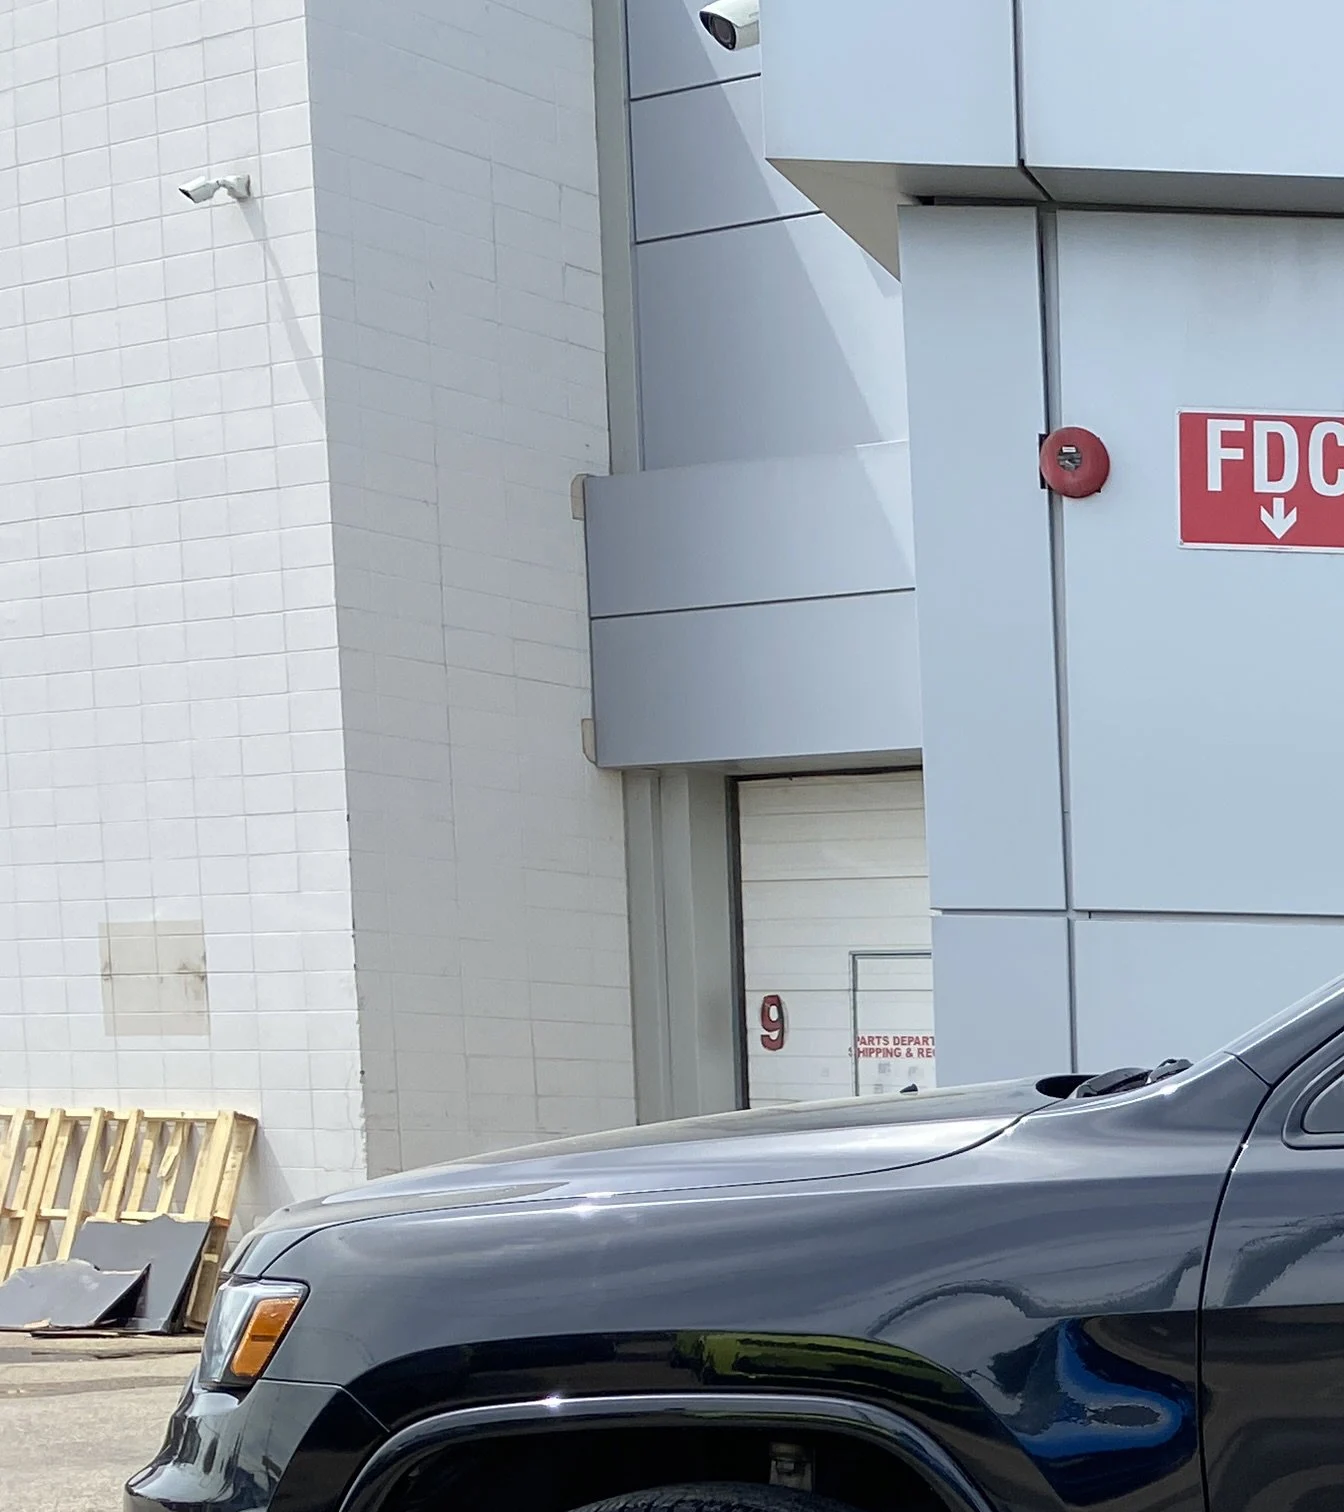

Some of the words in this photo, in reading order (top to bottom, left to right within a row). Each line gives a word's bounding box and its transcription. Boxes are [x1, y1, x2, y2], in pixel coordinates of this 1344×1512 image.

[760, 994, 785, 1052] 9
[905, 1048, 914, 1058] &
[917, 1047, 936, 1058] RE
